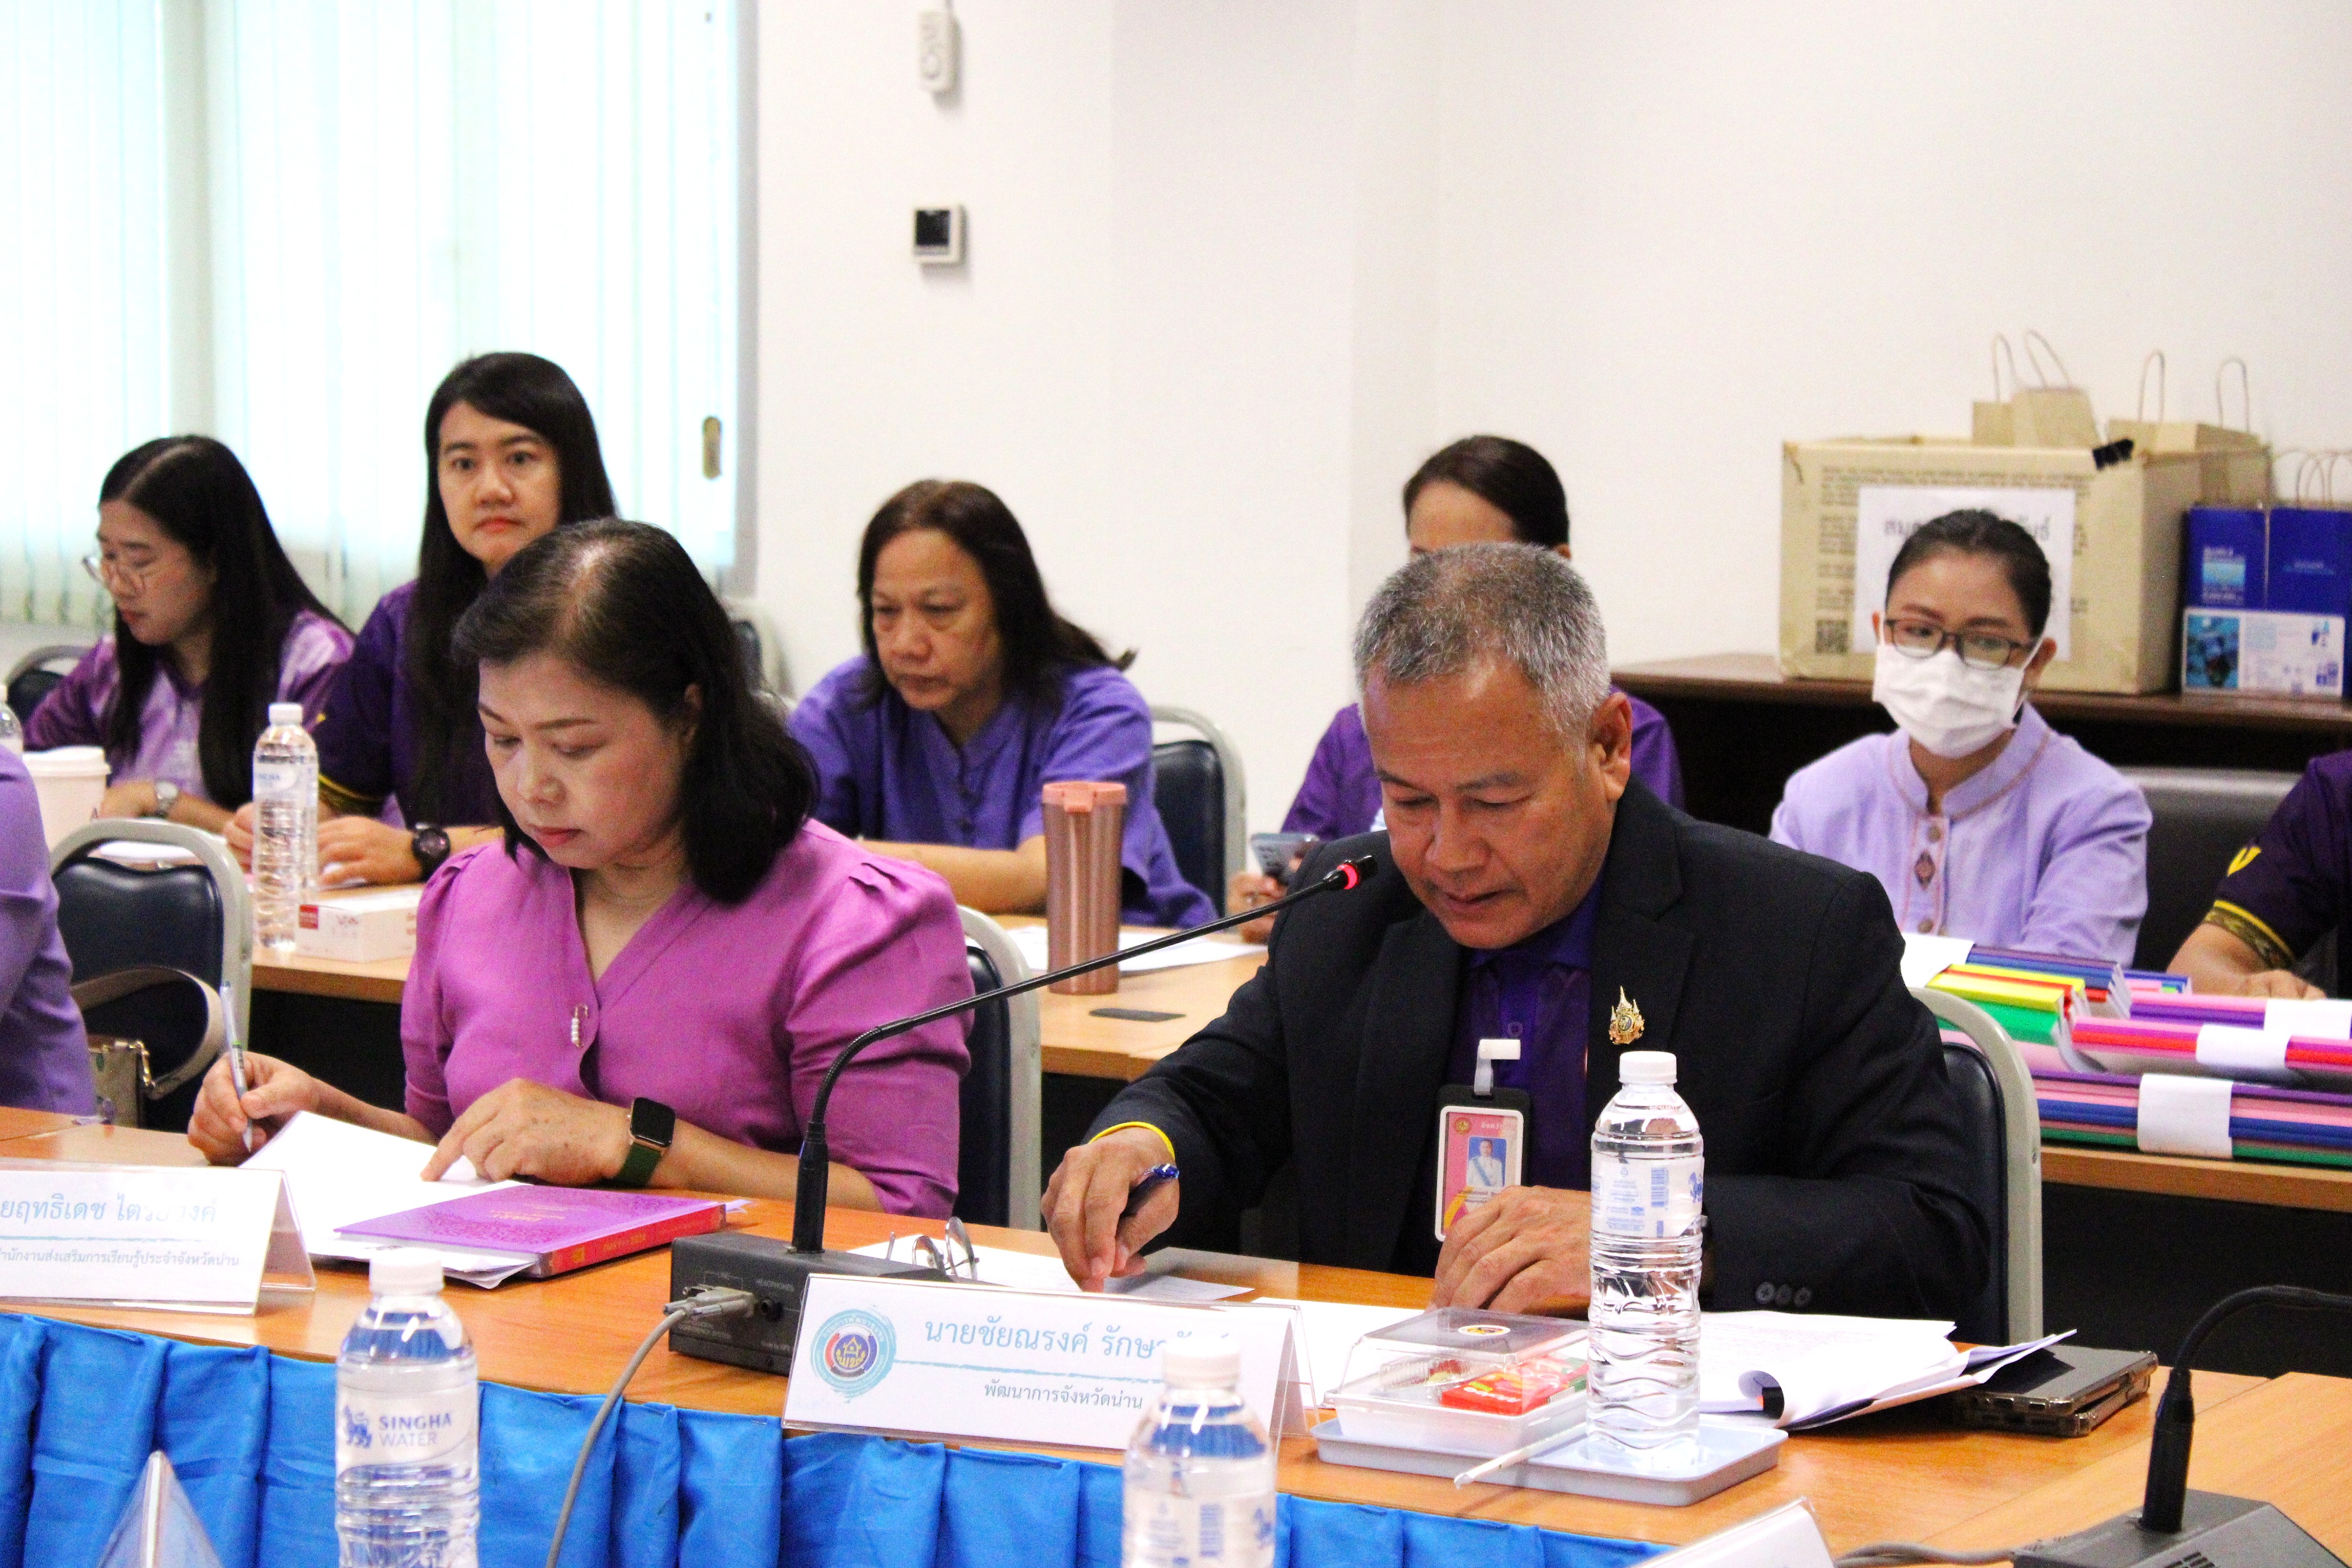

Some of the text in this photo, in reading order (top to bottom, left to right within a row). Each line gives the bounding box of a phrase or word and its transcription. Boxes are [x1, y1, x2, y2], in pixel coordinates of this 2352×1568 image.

[925, 1314, 1089, 1354] นายชัยณรงค์
[984, 1381, 1144, 1410] พัฒนาการจังหวัดน่าน
[379, 1413, 452, 1430] SINGHA
[379, 1432, 437, 1446] WATER
